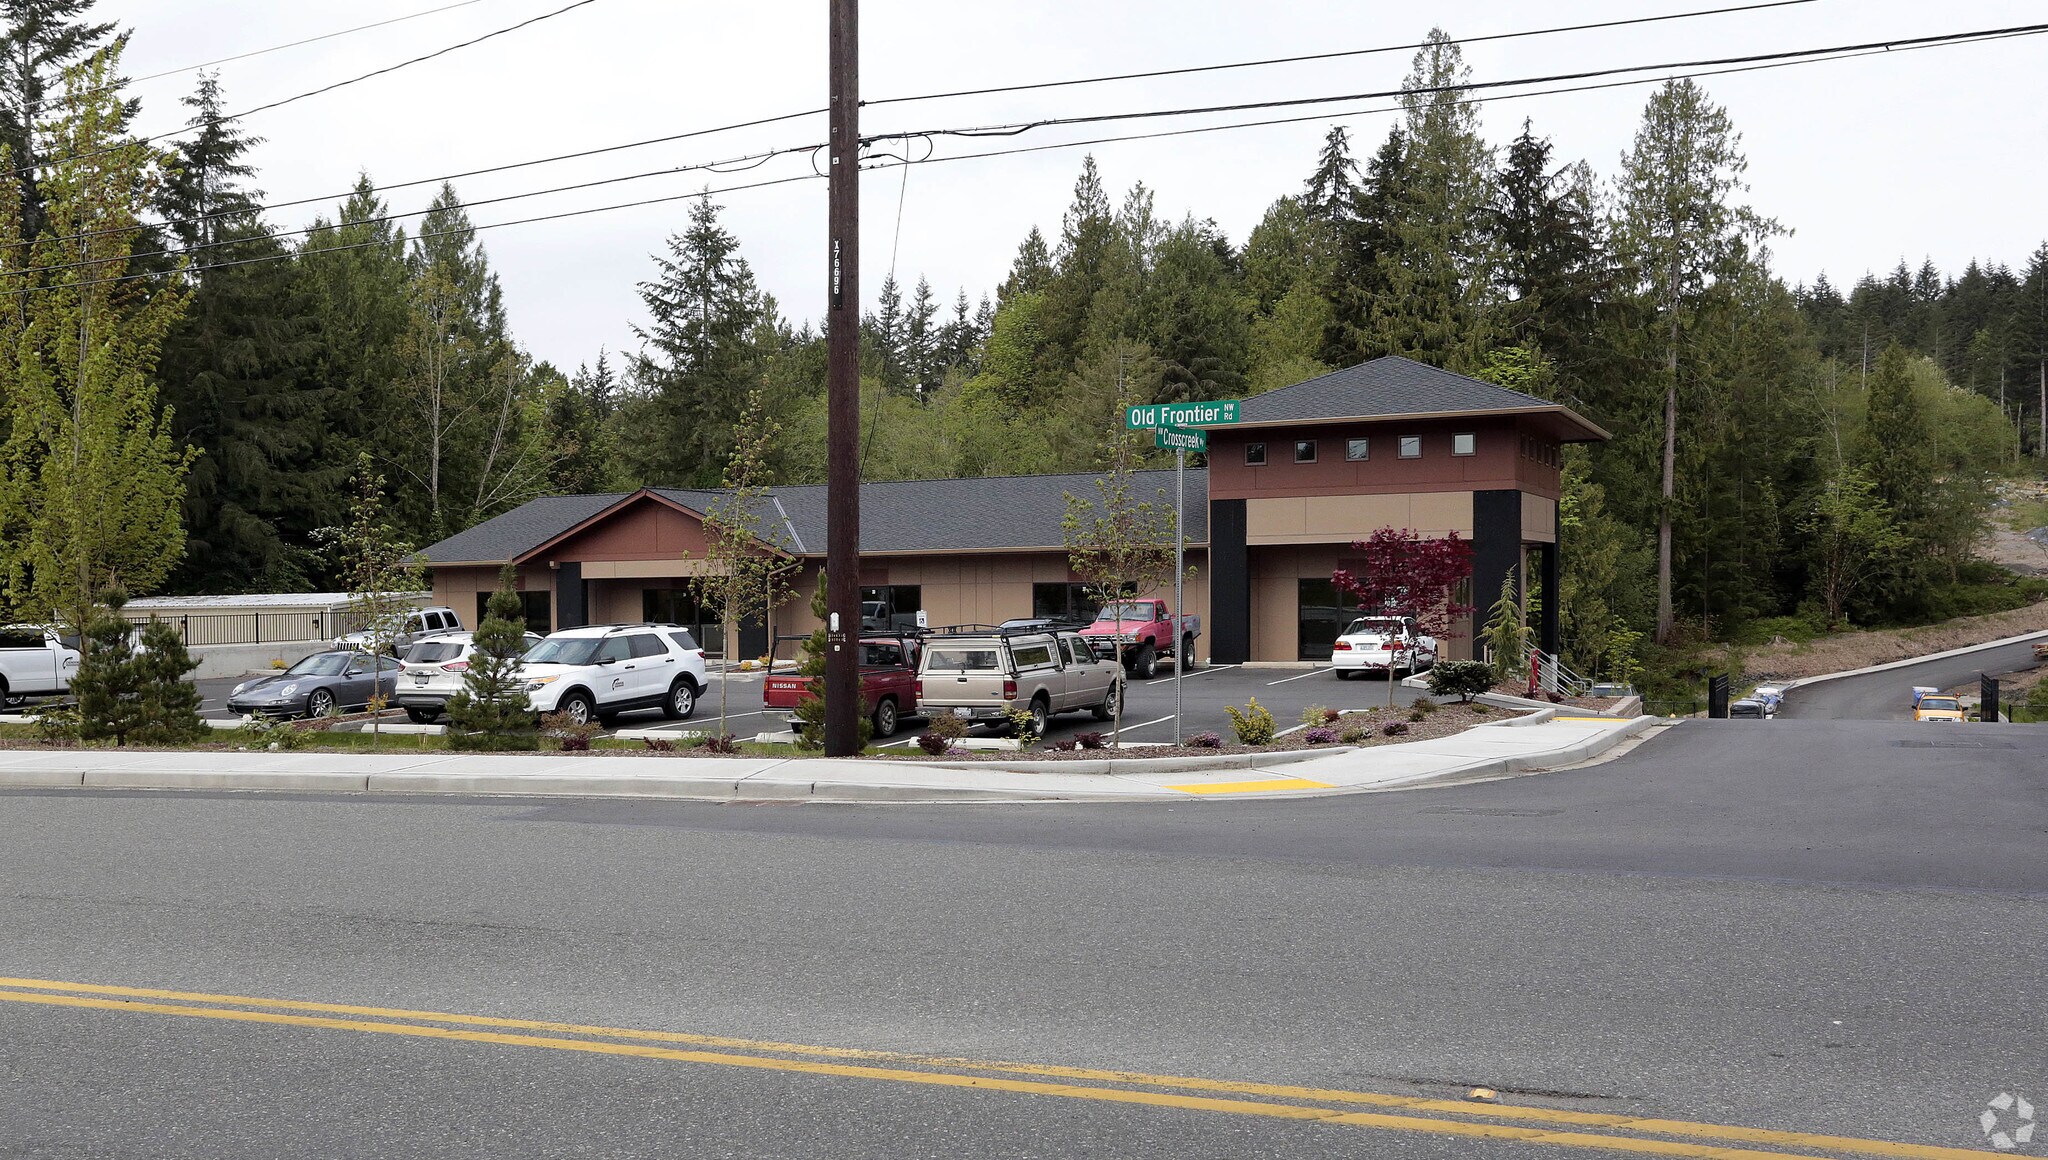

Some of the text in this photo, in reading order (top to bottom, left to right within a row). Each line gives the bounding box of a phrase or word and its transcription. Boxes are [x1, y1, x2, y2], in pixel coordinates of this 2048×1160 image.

[1224, 403, 1234, 411] NW
[1132, 405, 1220, 426] Old Frontier
[1224, 412, 1233, 420] Rd
[1163, 429, 1199, 448] Crosscreek
